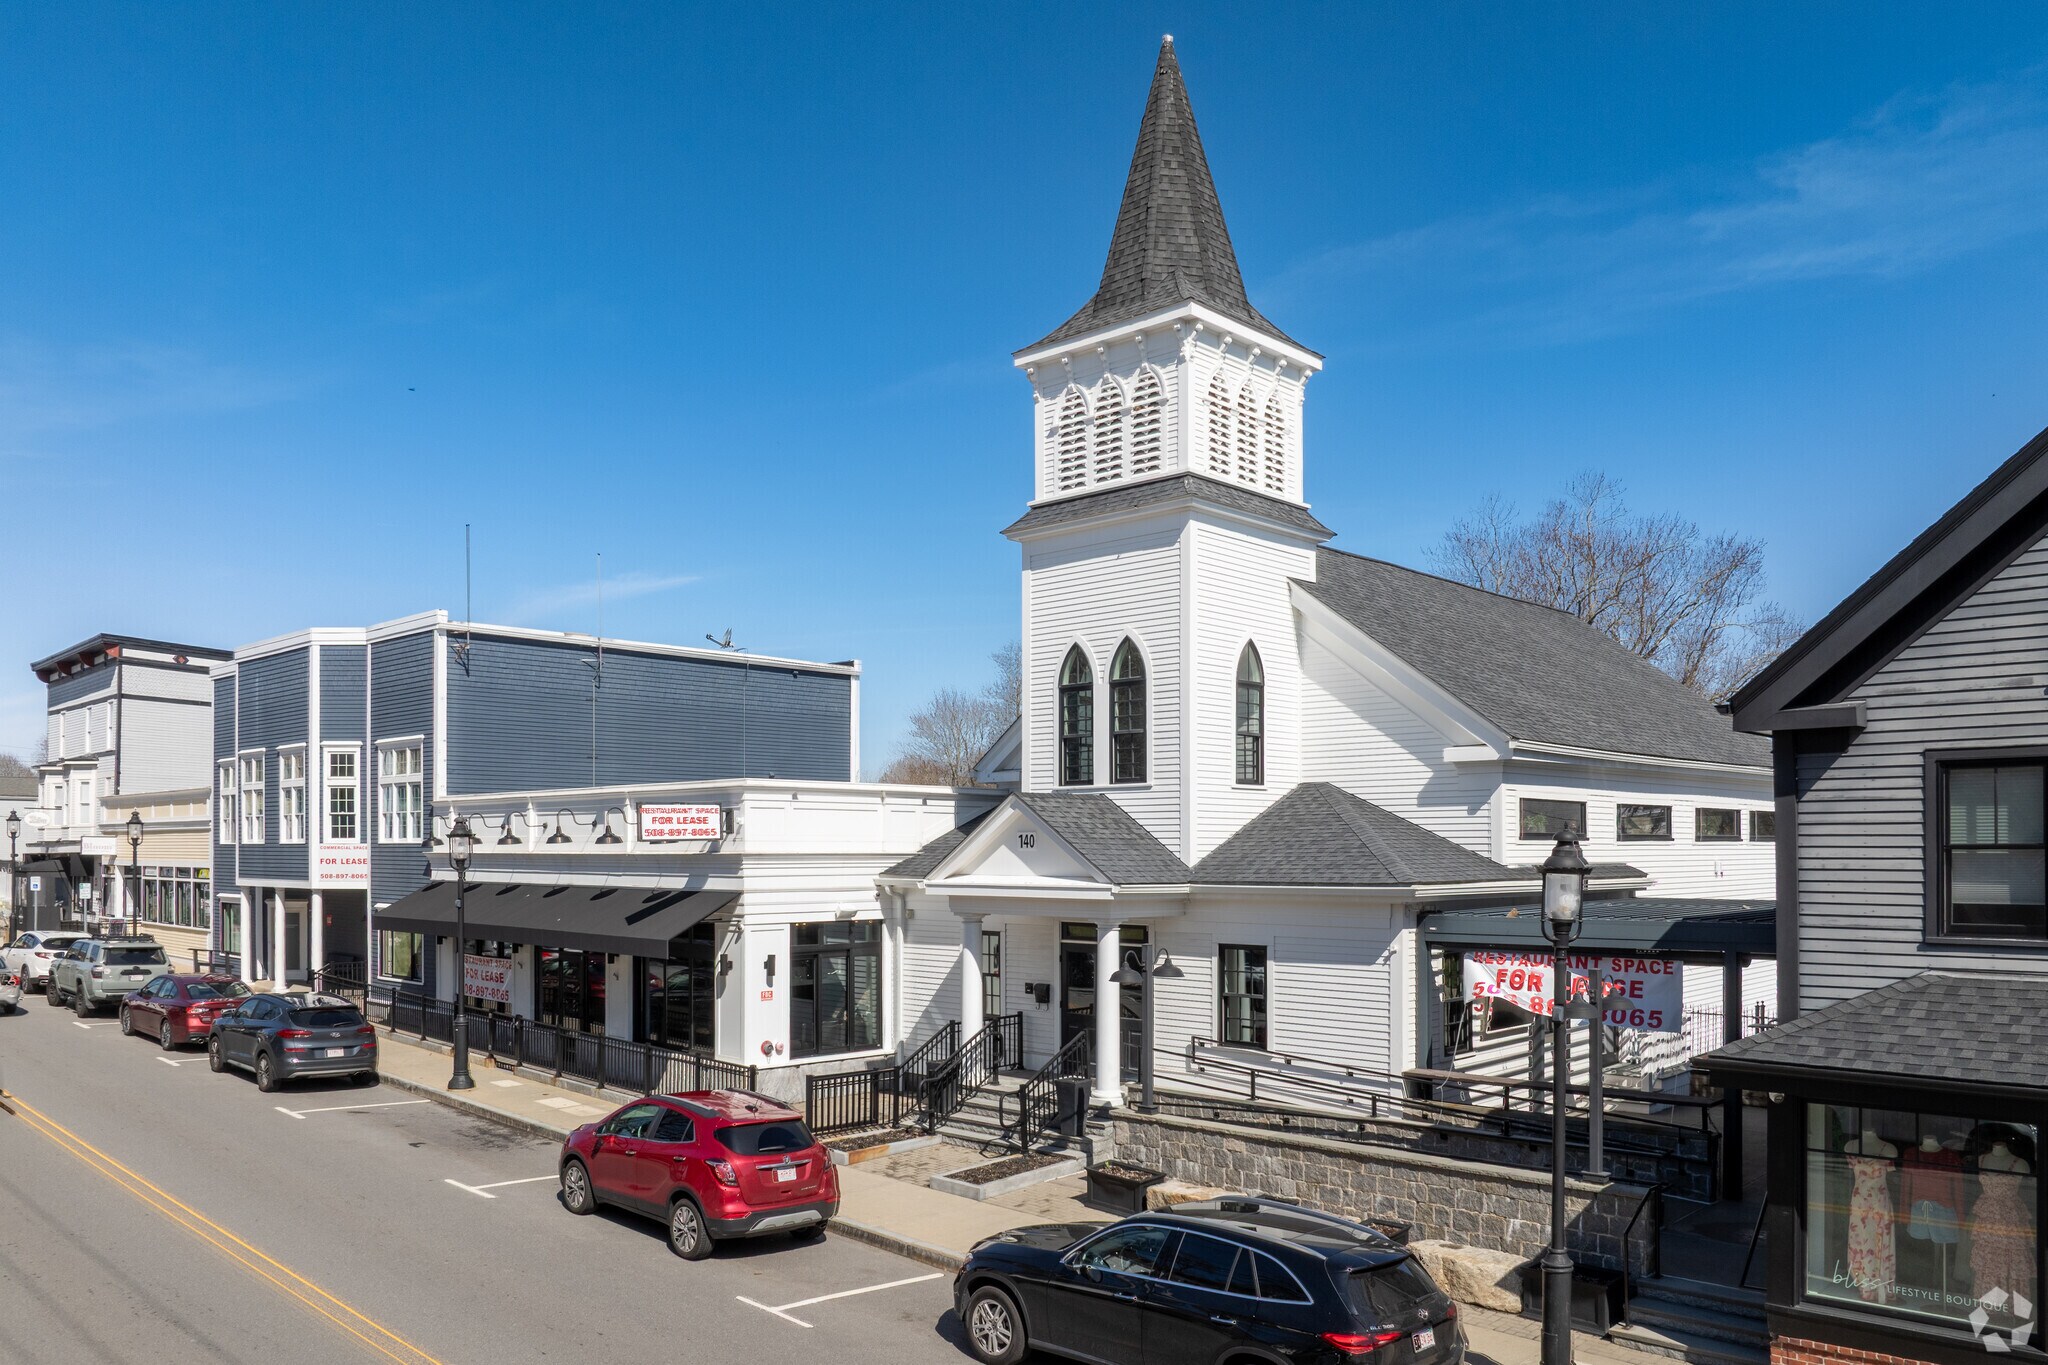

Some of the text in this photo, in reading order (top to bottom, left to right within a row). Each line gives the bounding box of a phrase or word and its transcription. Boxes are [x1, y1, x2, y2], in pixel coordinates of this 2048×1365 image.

[639, 807, 719, 815] RESTAURANT SPACE
[651, 816, 709, 825] FOR LEASE
[644, 828, 718, 837] 508-897-8065
[1018, 834, 1035, 848] 140
[1611, 957, 1674, 975] SPACE
[465, 967, 504, 984] FOR LEASE
[1496, 968, 1544, 993] FOR
[1832, 1259, 2009, 1314] bliss LIFESTYLE BOUTIQUE
